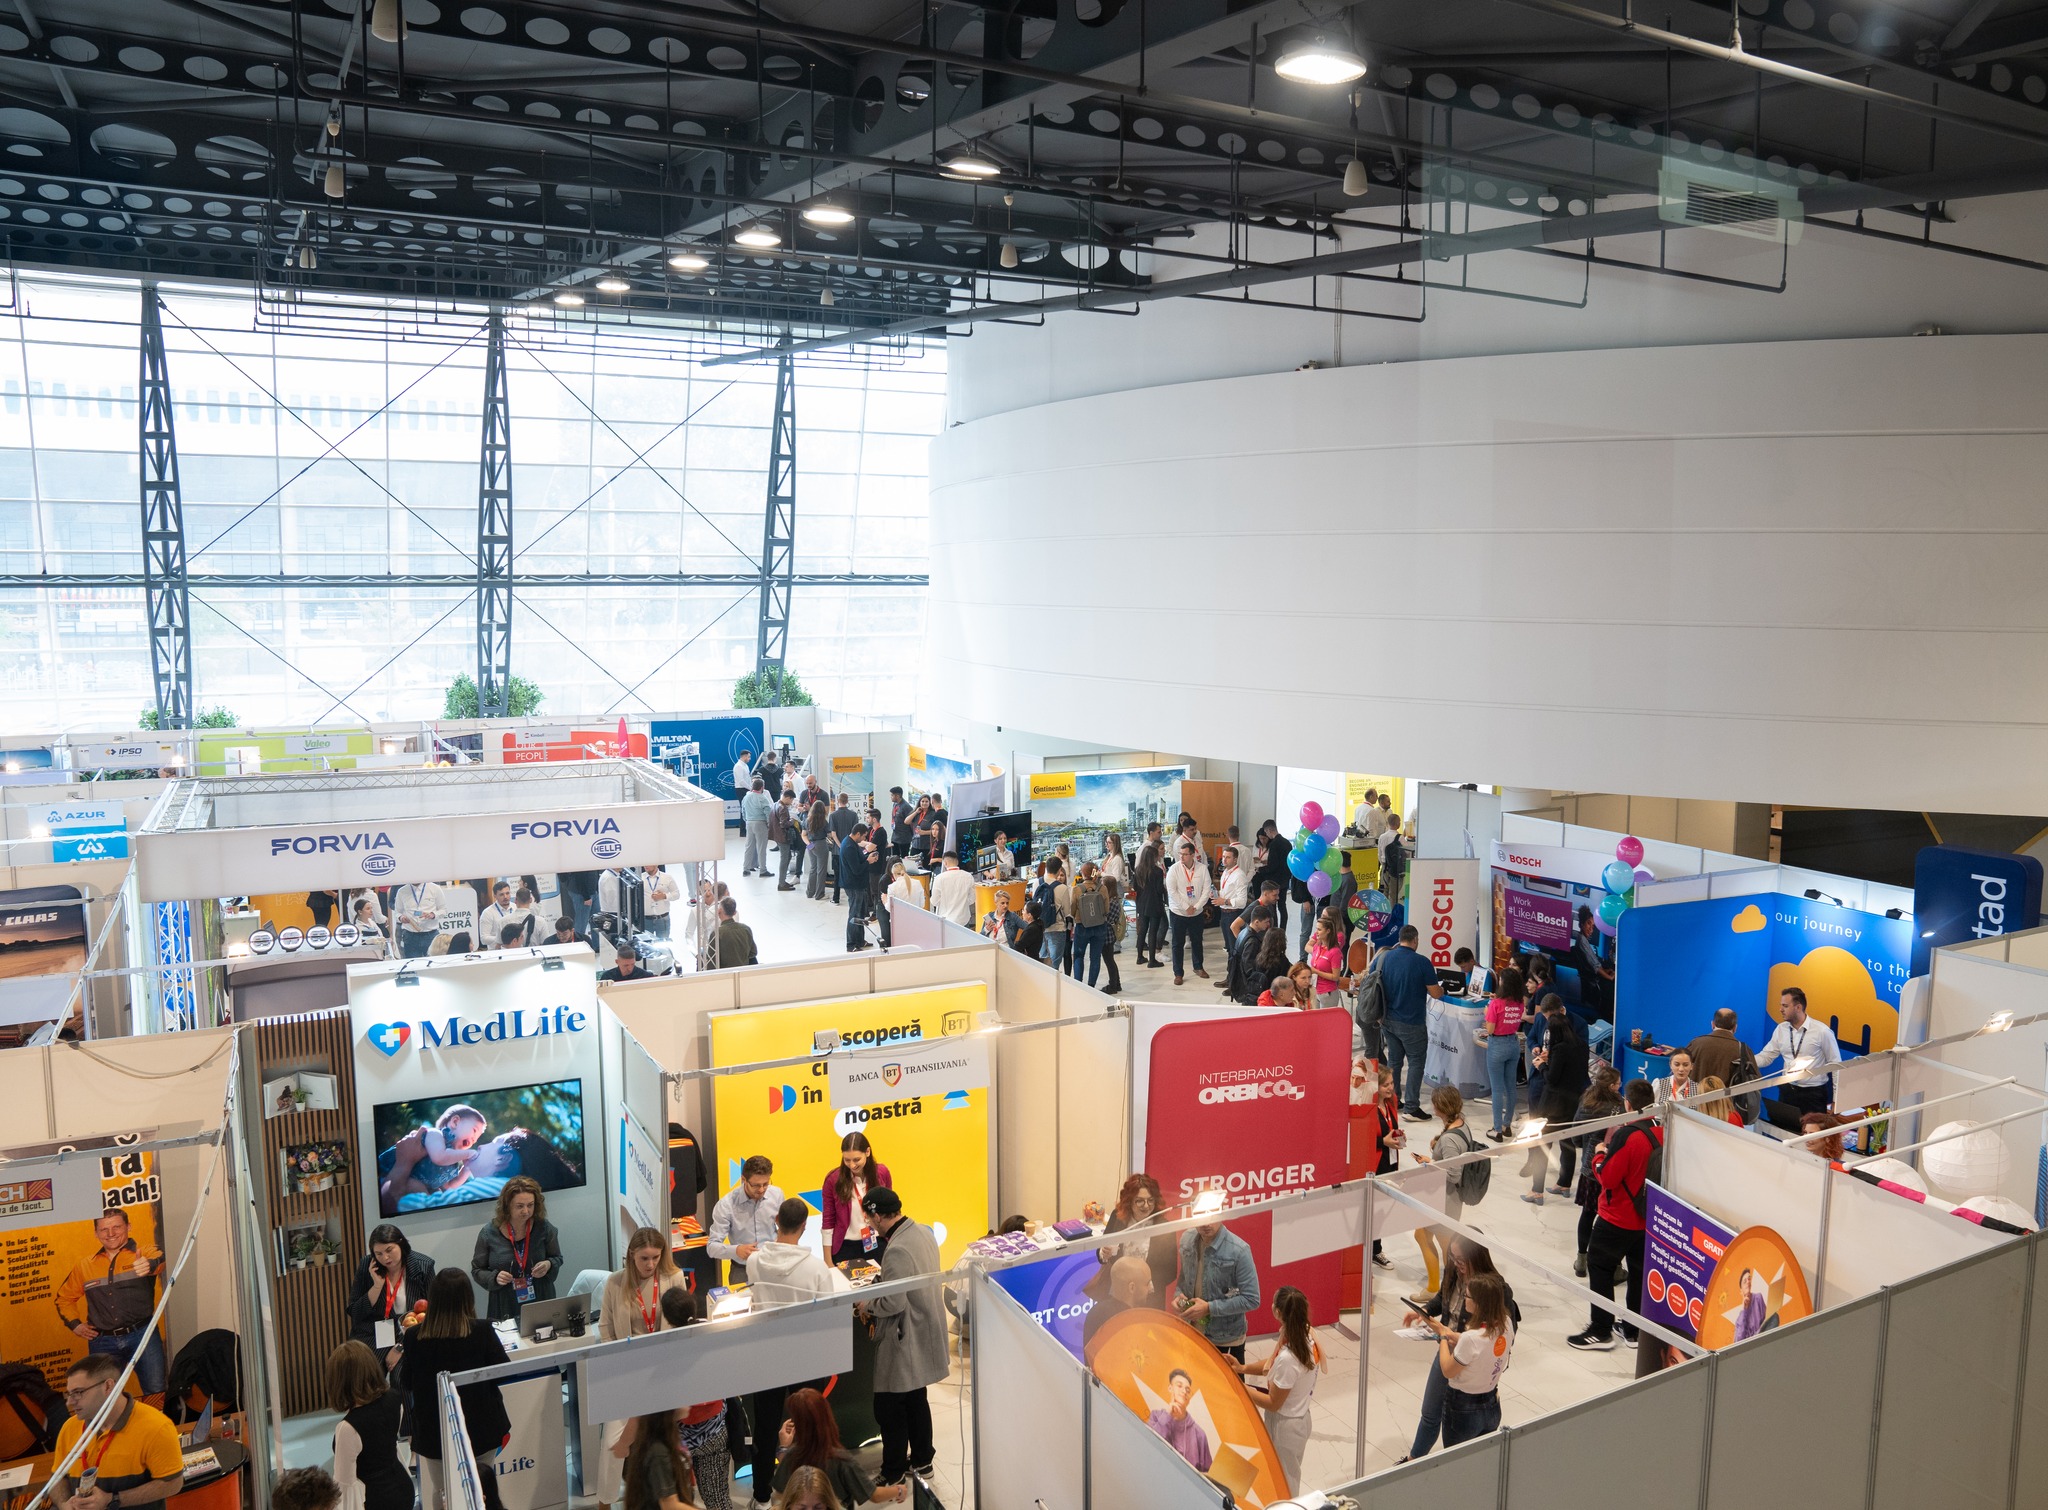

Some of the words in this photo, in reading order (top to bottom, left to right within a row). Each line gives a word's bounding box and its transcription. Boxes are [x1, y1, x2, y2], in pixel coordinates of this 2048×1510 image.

[304, 739, 331, 748] Valeo
[651, 735, 692, 743] AMILTON
[118, 747, 143, 755] IPSO
[1033, 784, 1067, 794] Continental
[65, 811, 106, 820] AZUR
[511, 817, 621, 840] FORVIA
[271, 832, 394, 856] FORVIA
[593, 843, 622, 853] HELLA
[364, 859, 396, 869] HELLA
[1509, 854, 1542, 868] BOSCH
[1355, 871, 1377, 881] itesco
[1513, 895, 1532, 907] Work
[1970, 873, 2008, 939] tad
[5, 911, 58, 926] CLAAS
[438, 917, 472, 930] ASTRĂ
[1431, 878, 1454, 967] BOSCH
[1508, 906, 1568, 928] #LikeABosch
[1775, 912, 1799, 925] our
[1803, 915, 1862, 942] journey
[1867, 958, 1883, 972] to
[420, 1004, 587, 1050] MedLife
[947, 1018, 965, 1031] BT
[814, 1019, 921, 1050] scoperă
[848, 1071, 880, 1083] BANCA
[886, 1068, 898, 1078] BT
[903, 1059, 968, 1075] TRANSILVANIA
[1199, 1064, 1294, 1085] INTERBRANDS
[801, 1085, 823, 1105] în
[1198, 1079, 1293, 1105] ORBICO
[844, 1096, 922, 1125] noastră
[1179, 1163, 1316, 1199] STRONGER
[102, 1176, 160, 1209] ach!
[9, 1203, 19, 1213] de
[1654, 1204, 1663, 1216] Hai
[1662, 1210, 1677, 1224] acum
[1676, 1218, 1683, 1228] la
[1657, 1217, 1689, 1241] mini-sesiune
[6, 1246, 28, 1255] muncă
[30, 1242, 48, 1251] sigur
[17, 1238, 28, 1246] loc
[1652, 1224, 1660, 1232] de
[1659, 1229, 1682, 1249] coaching
[1682, 1242, 1706, 1263] financiar!
[1651, 1241, 1670, 1260] Planifici
[8, 1259, 49, 1273] specialitate
[1650, 1252, 1657, 1261] ca
[1667, 1264, 1695, 1286] gestionezi
[1694, 1282, 1704, 1293] mai
[9, 1280, 27, 1289] lucru
[29, 1275, 50, 1286] plăcut
[9, 1284, 51, 1297] Dezvoltarea
[10, 1297, 25, 1305] unei
[27, 1292, 52, 1302] cariere
[1030, 1307, 1055, 1325] BT
[49, 1357, 71, 1366] pentru
[493, 1456, 535, 1477] Life
